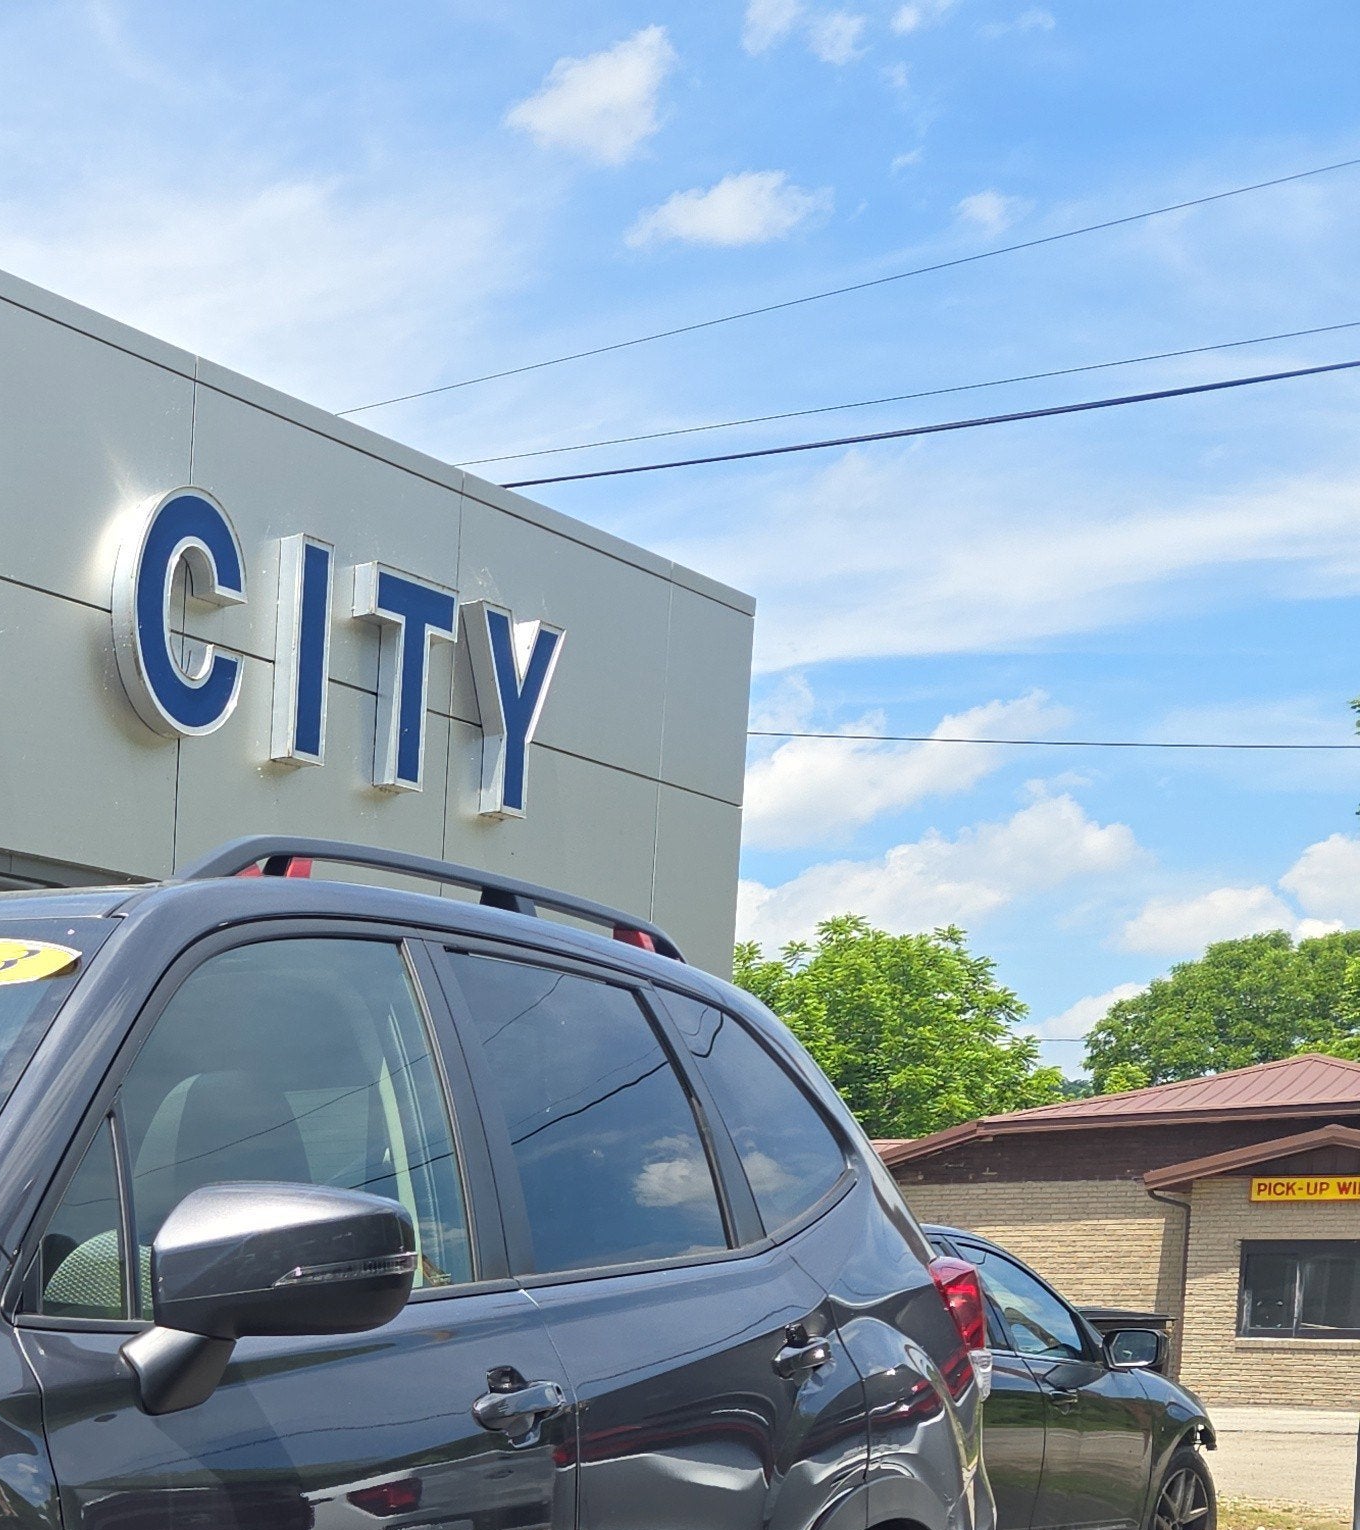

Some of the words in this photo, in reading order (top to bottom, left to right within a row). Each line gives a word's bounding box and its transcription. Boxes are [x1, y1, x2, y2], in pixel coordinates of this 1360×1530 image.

[112, 487, 568, 822] CITY
[1256, 1181, 1330, 1196] PICK-UP
[1337, 1181, 1360, 1196] WI
